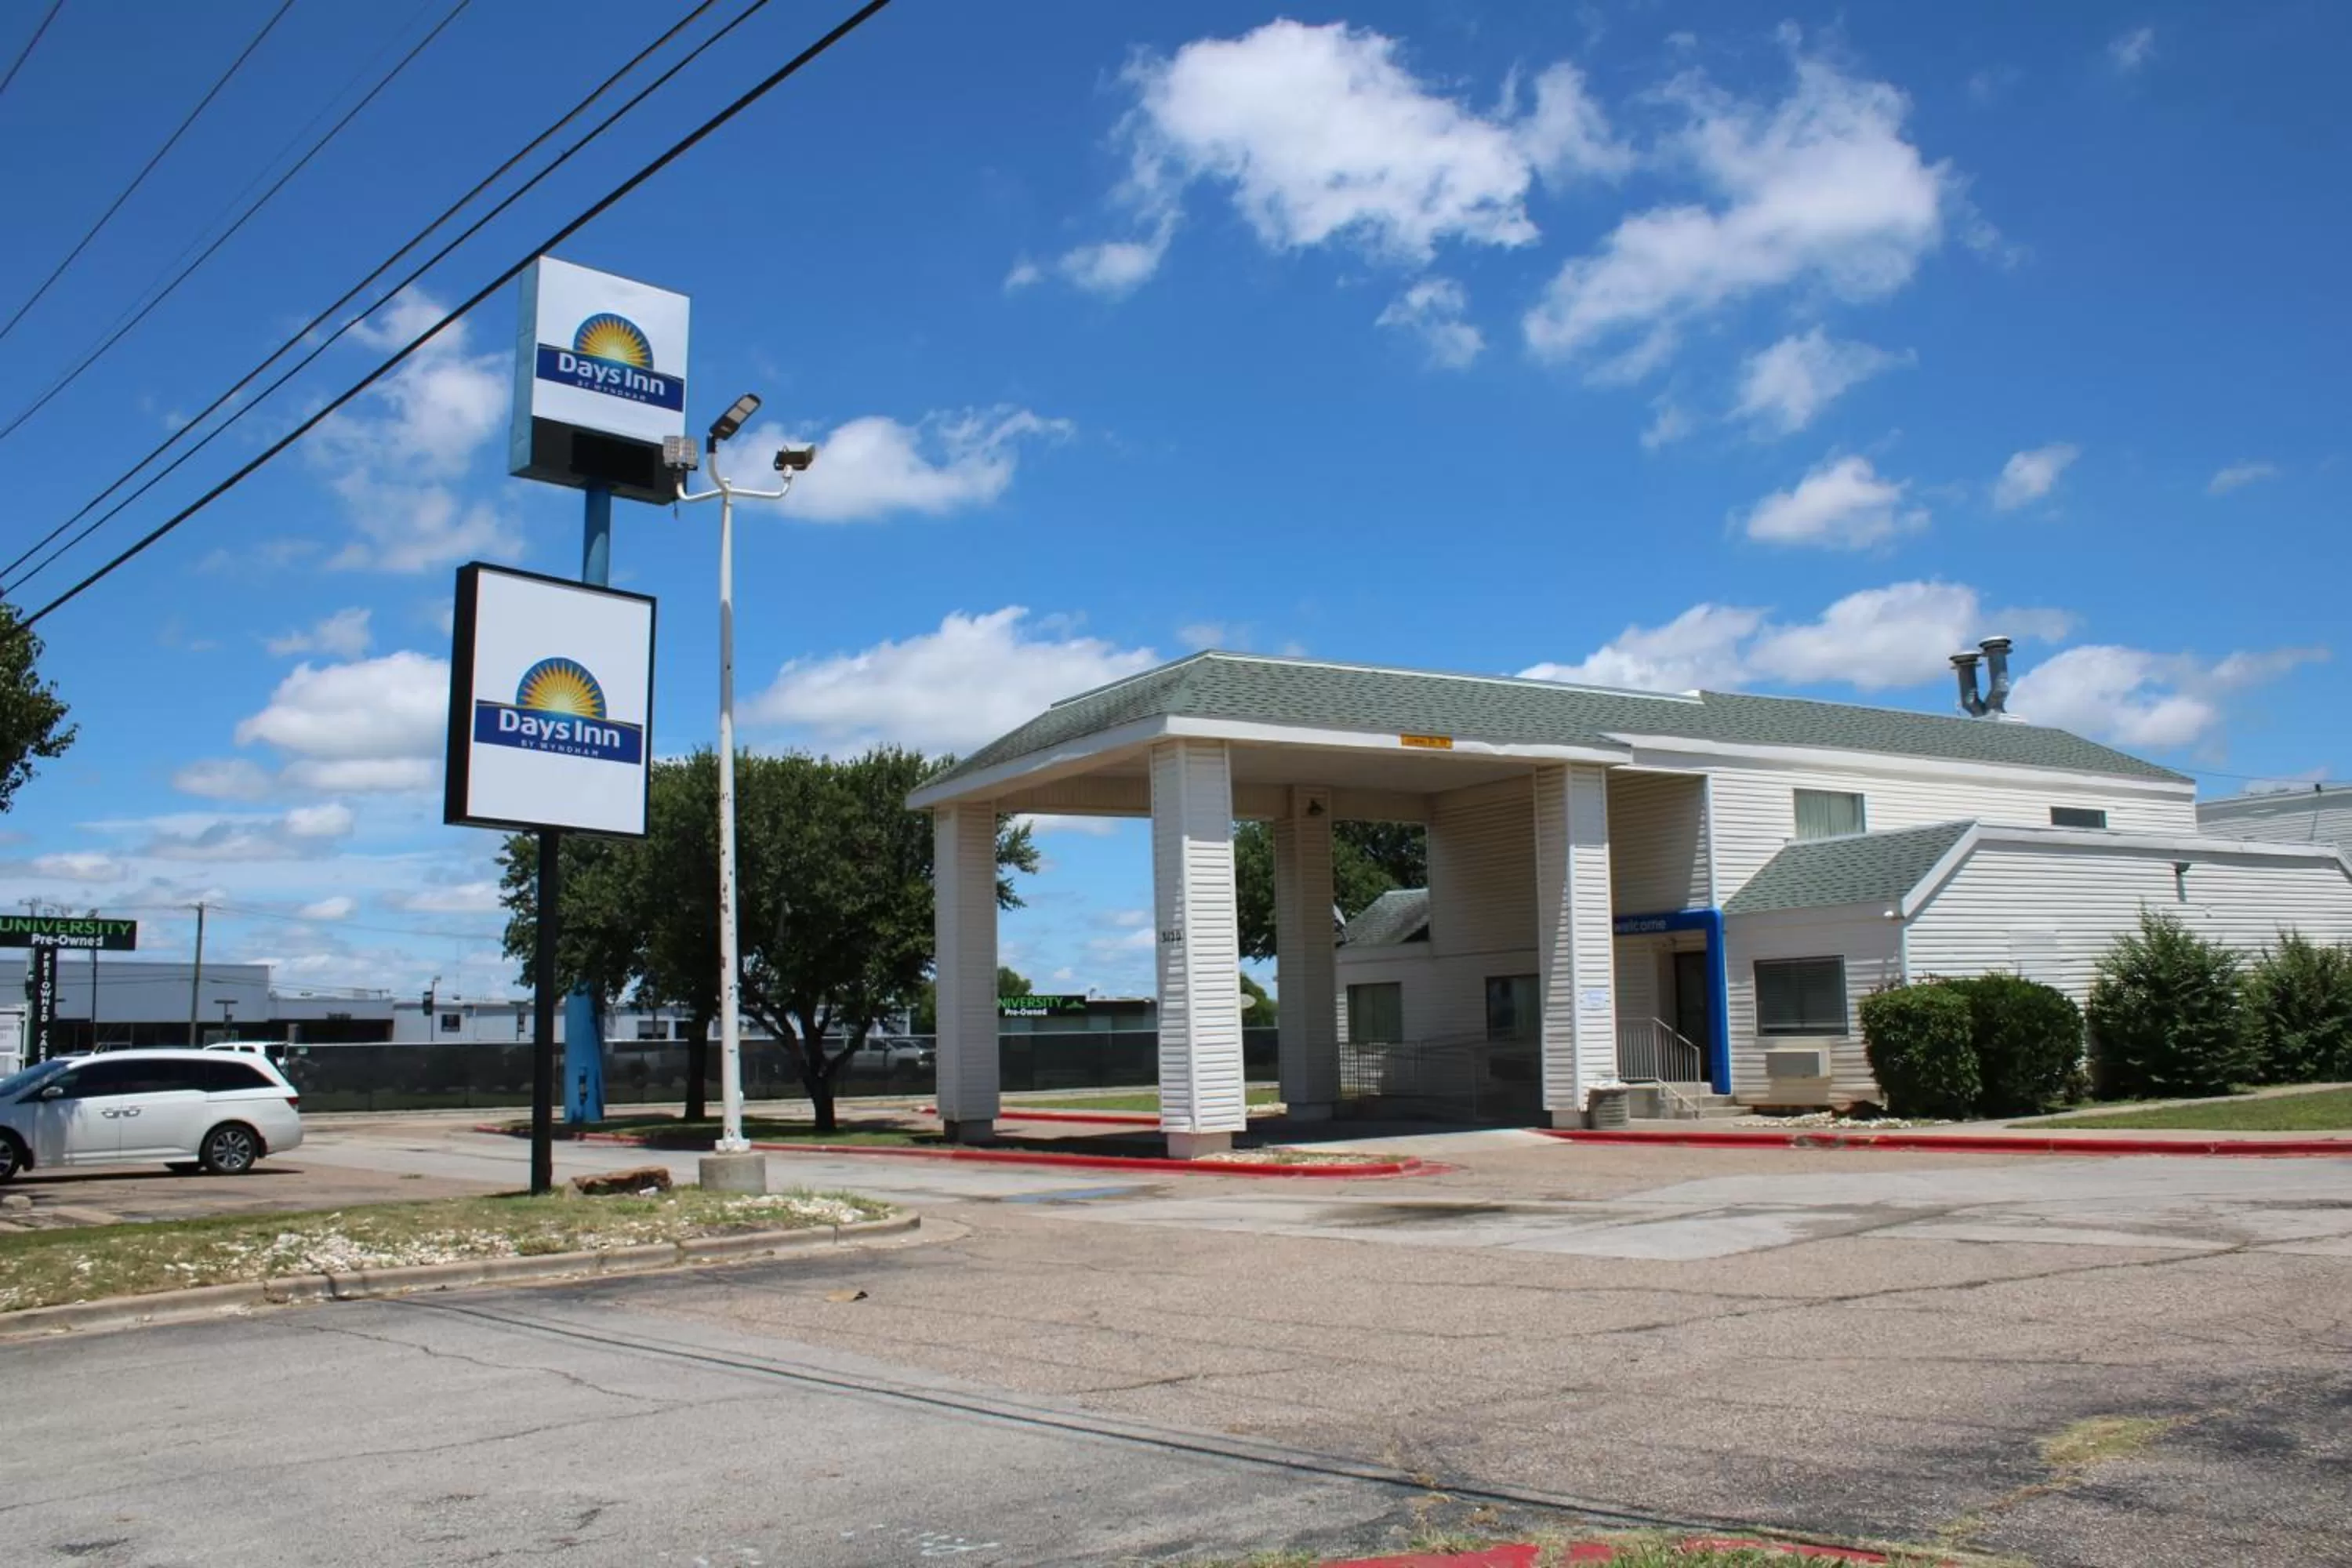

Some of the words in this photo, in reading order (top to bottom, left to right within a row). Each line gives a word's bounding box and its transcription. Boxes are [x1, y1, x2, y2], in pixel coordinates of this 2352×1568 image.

[558, 353, 621, 384] Days
[625, 368, 665, 396] Inn
[594, 383, 647, 401] WYNDHAM
[499, 709, 570, 740] Days
[575, 720, 620, 748] Inn
[521, 739, 534, 748] BY
[540, 742, 599, 757] WYNDHAM
[0, 919, 132, 935] UNIVERSITY
[31, 934, 103, 947] Pre-Owned
[997, 996, 1062, 1008] NIVERSITY
